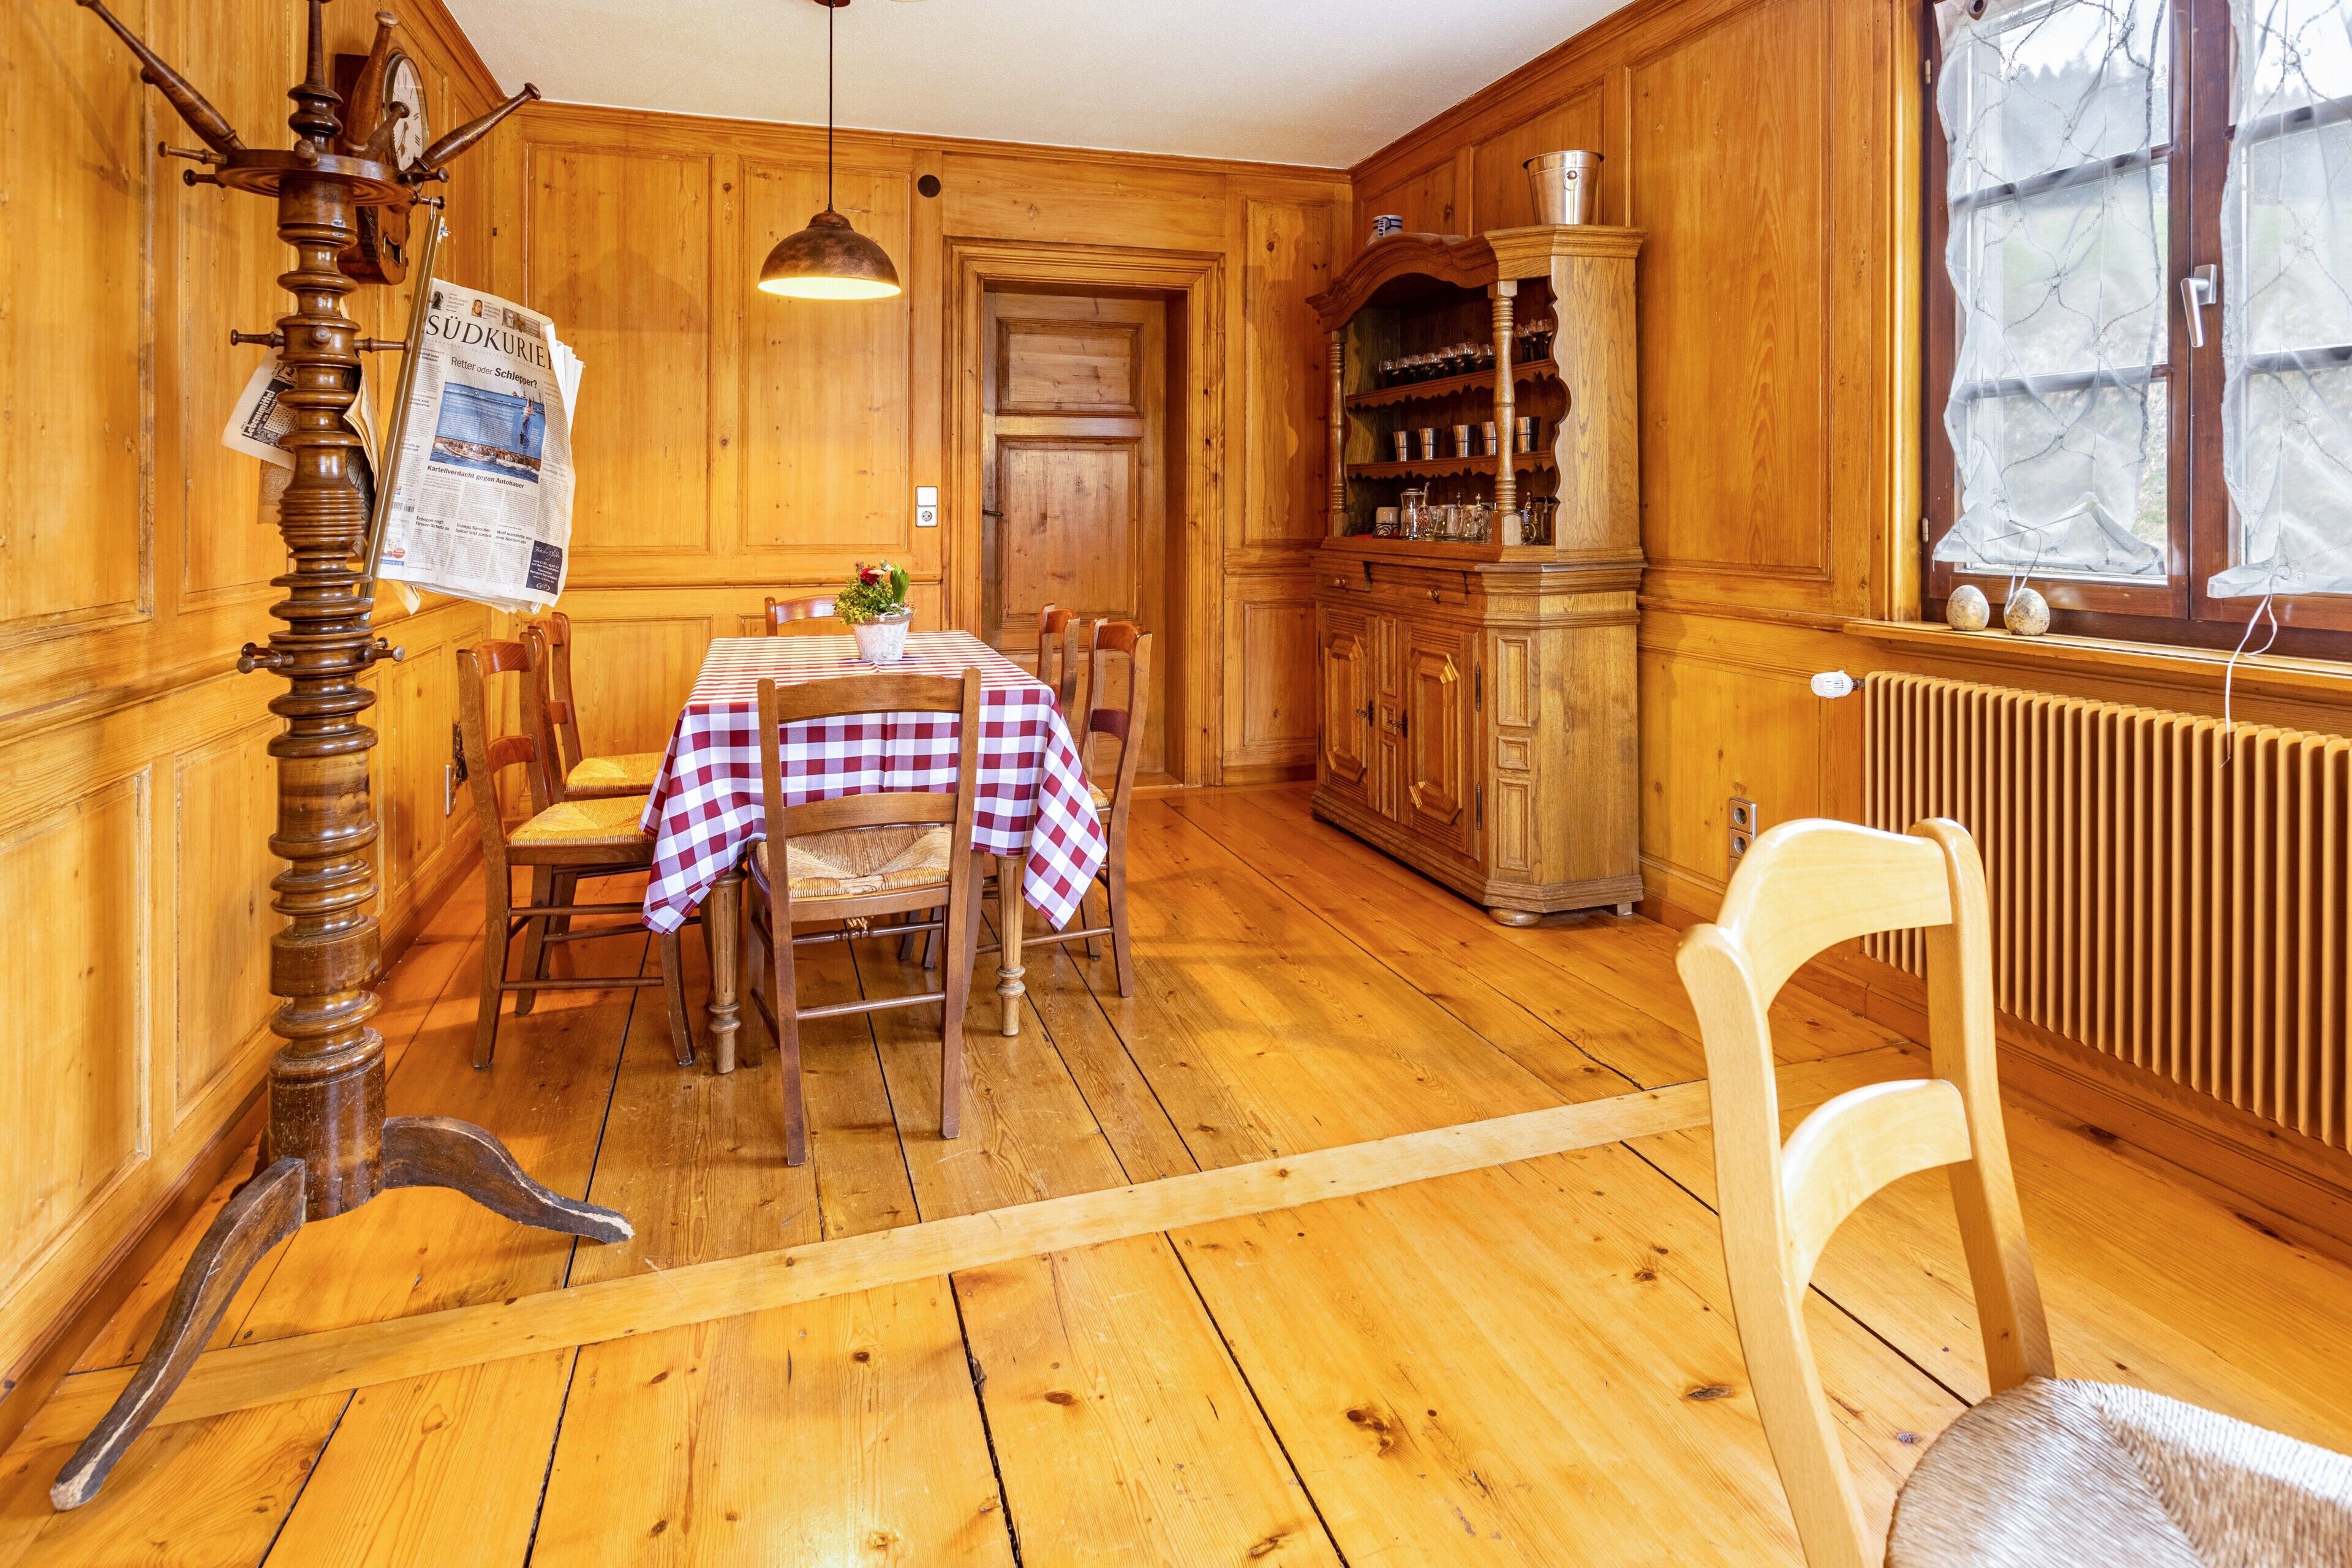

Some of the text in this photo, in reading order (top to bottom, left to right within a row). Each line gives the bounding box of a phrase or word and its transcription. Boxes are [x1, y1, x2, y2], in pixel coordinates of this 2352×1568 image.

[451, 356, 477, 371] Retter
[477, 365, 493, 375] oder
[494, 368, 538, 389] Schlepper?
[427, 464, 525, 489] Kartellverdacht gegen Autobauer
